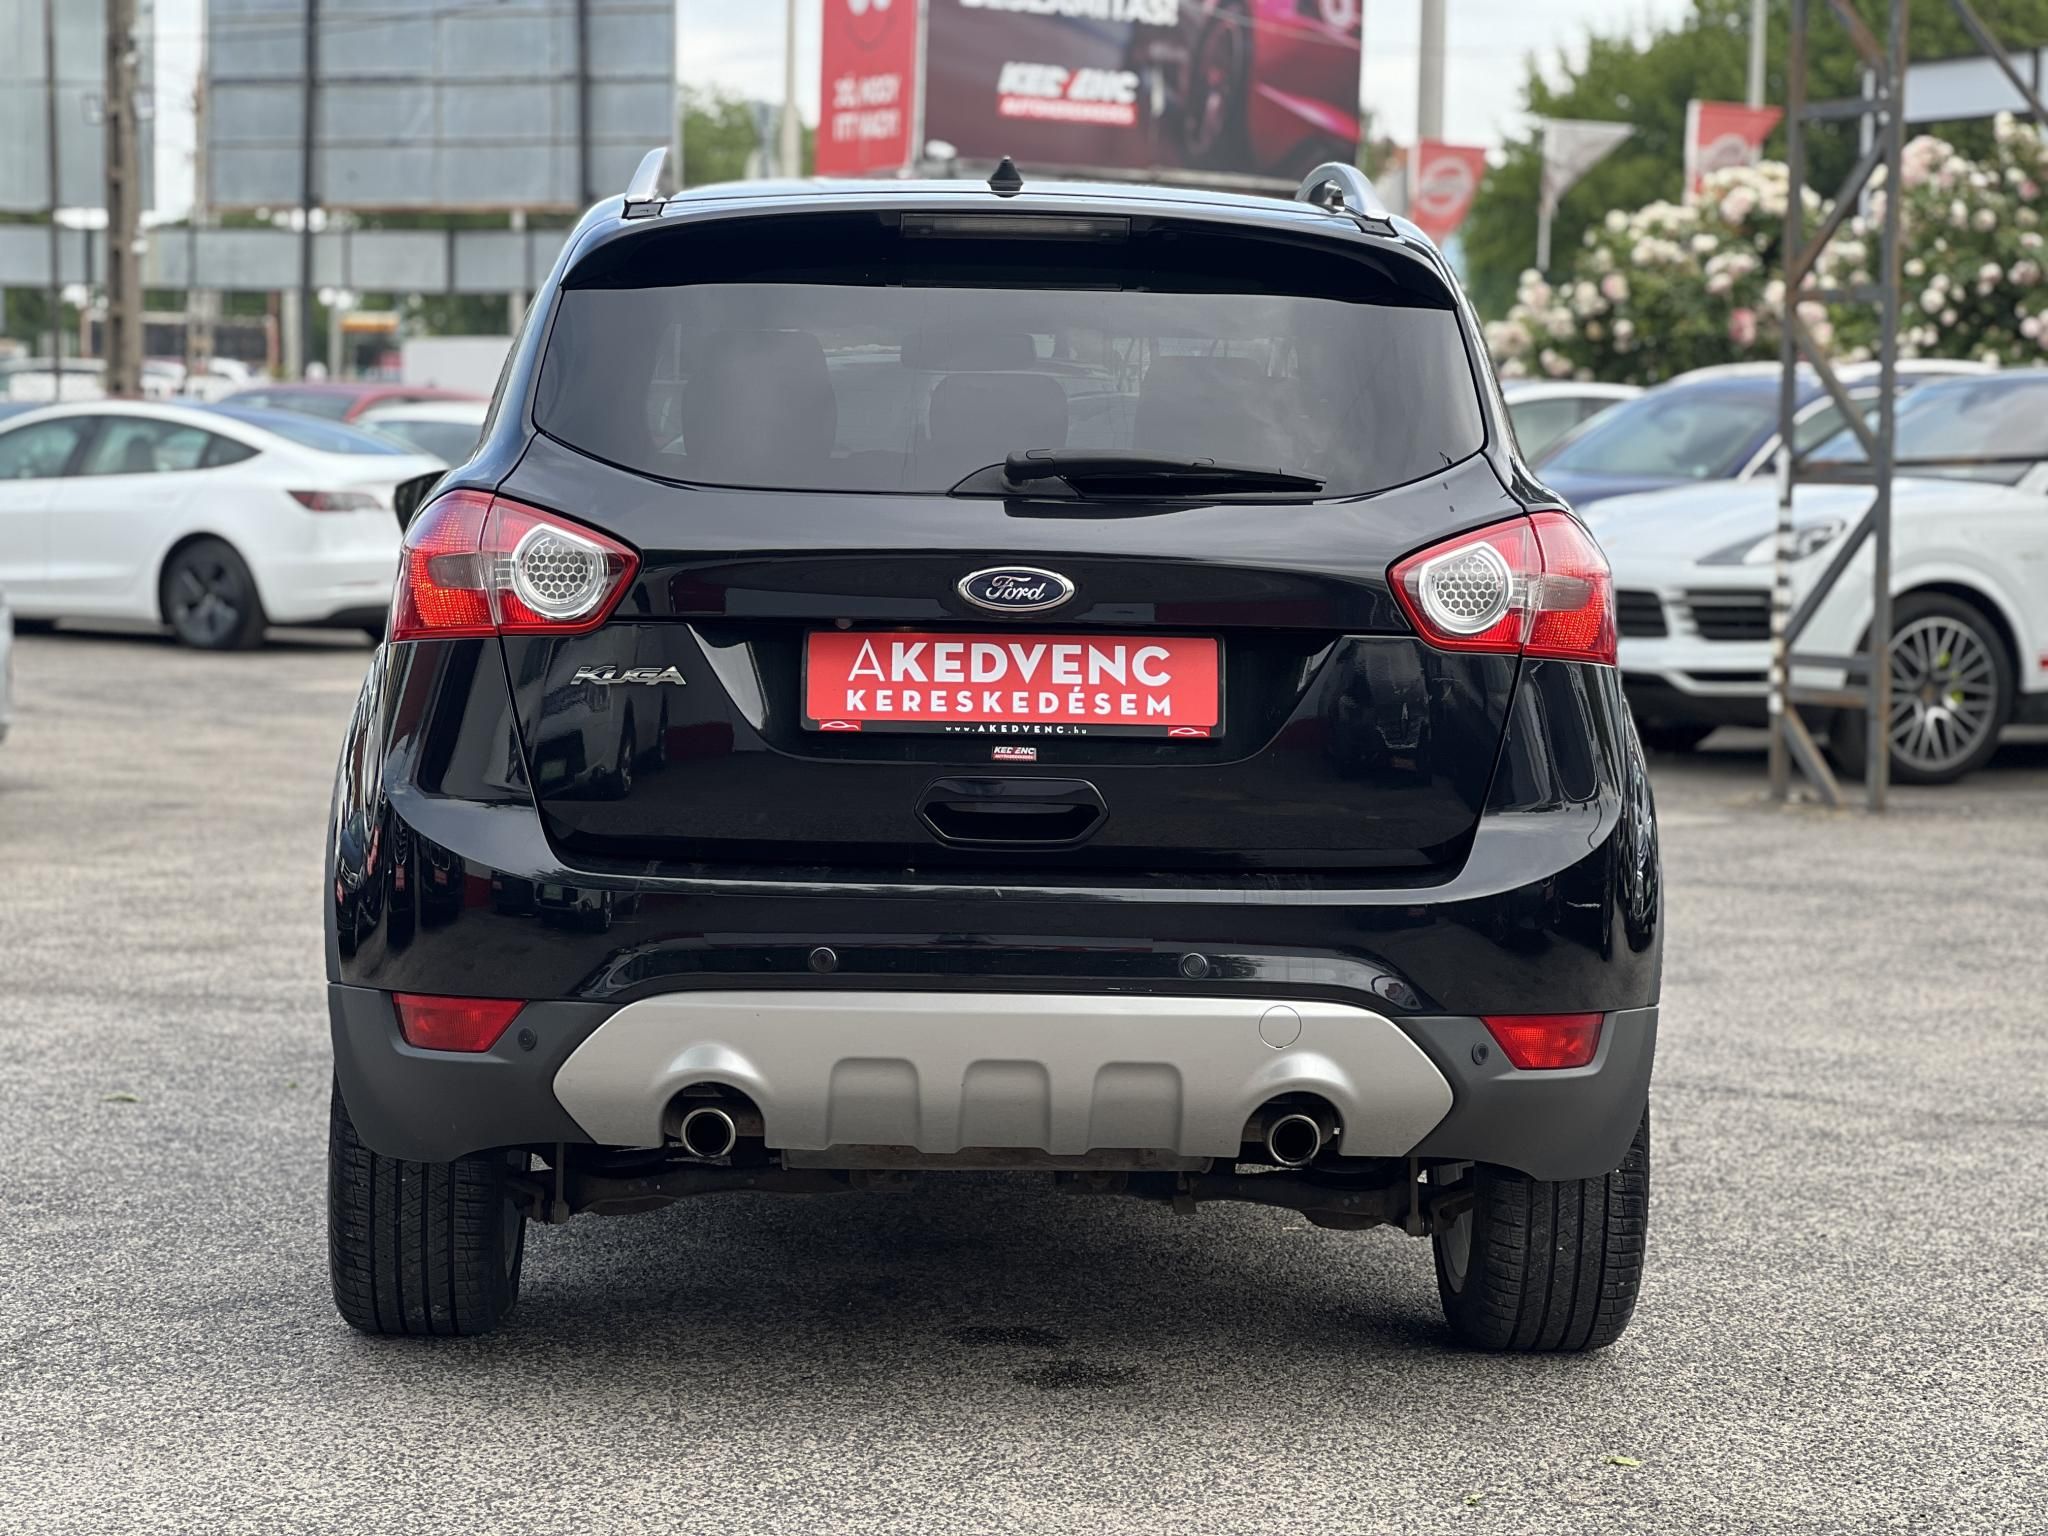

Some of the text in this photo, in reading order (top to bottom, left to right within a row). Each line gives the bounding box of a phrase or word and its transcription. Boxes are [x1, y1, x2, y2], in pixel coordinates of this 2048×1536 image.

[985, 575, 1047, 601] Ford
[570, 665, 687, 685] KUGA
[847, 638, 1172, 687] AKEDVENC
[846, 686, 1172, 717] KERESKEDÉSEM
[945, 724, 1087, 735] www.AKEDVENC.hu
